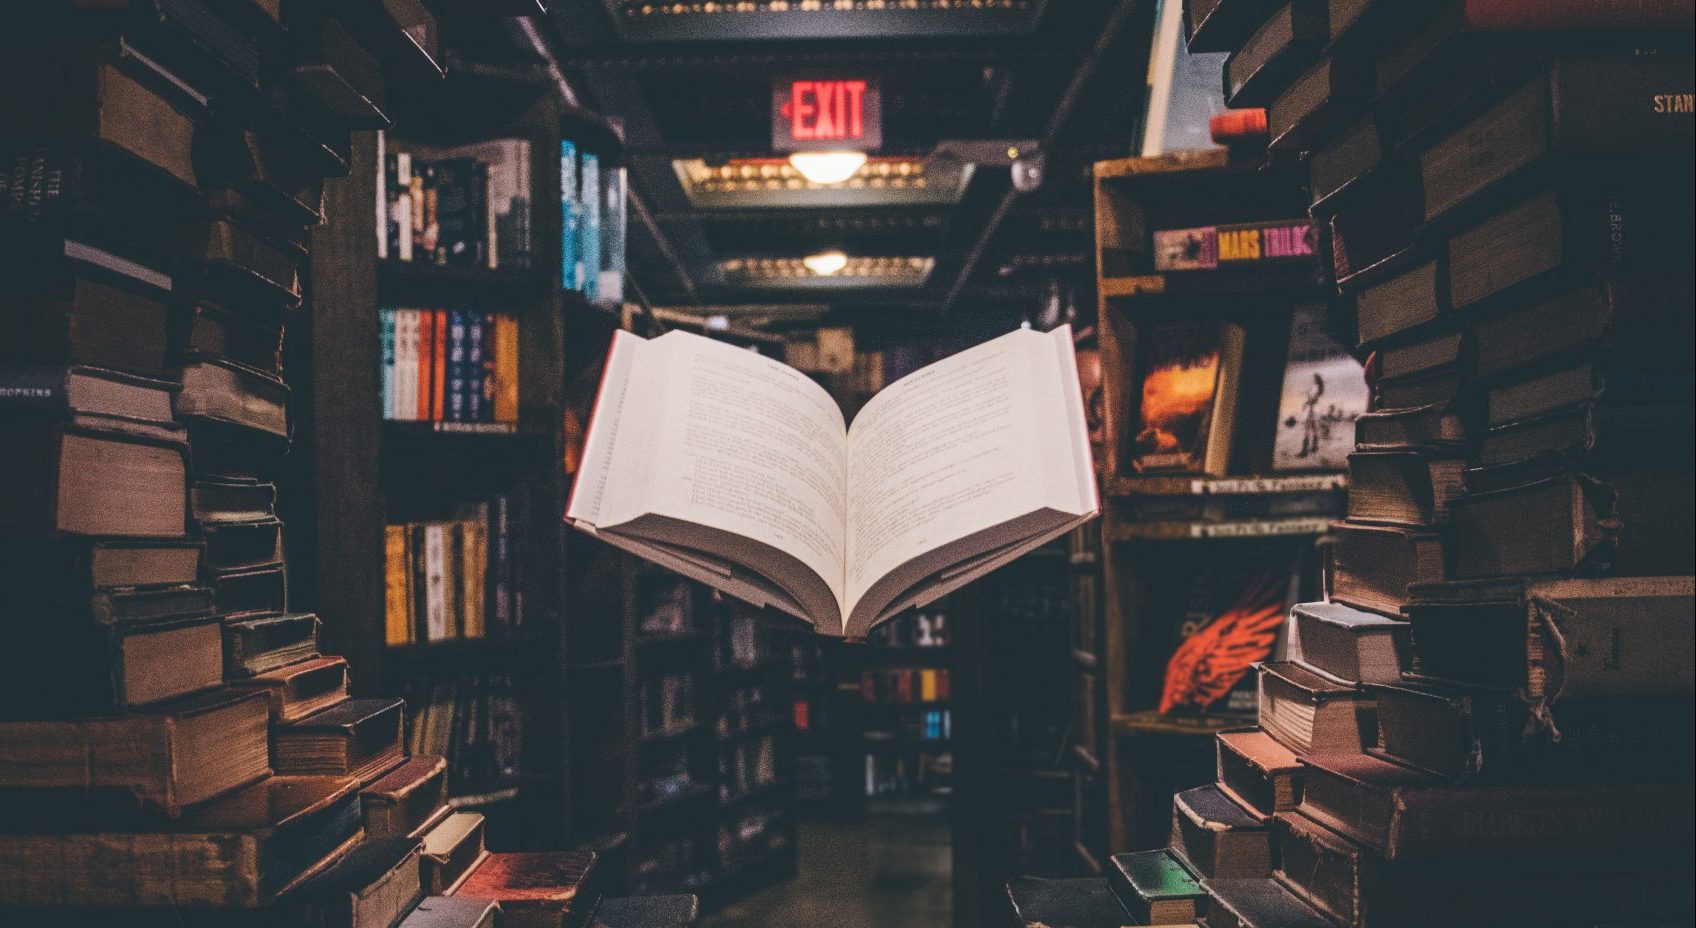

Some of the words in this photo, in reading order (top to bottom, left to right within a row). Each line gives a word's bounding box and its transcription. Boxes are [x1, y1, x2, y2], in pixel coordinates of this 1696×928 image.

[793, 82, 866, 138] EXIT
[1654, 94, 1694, 113] STAN
[1218, 229, 1260, 260] MARS
